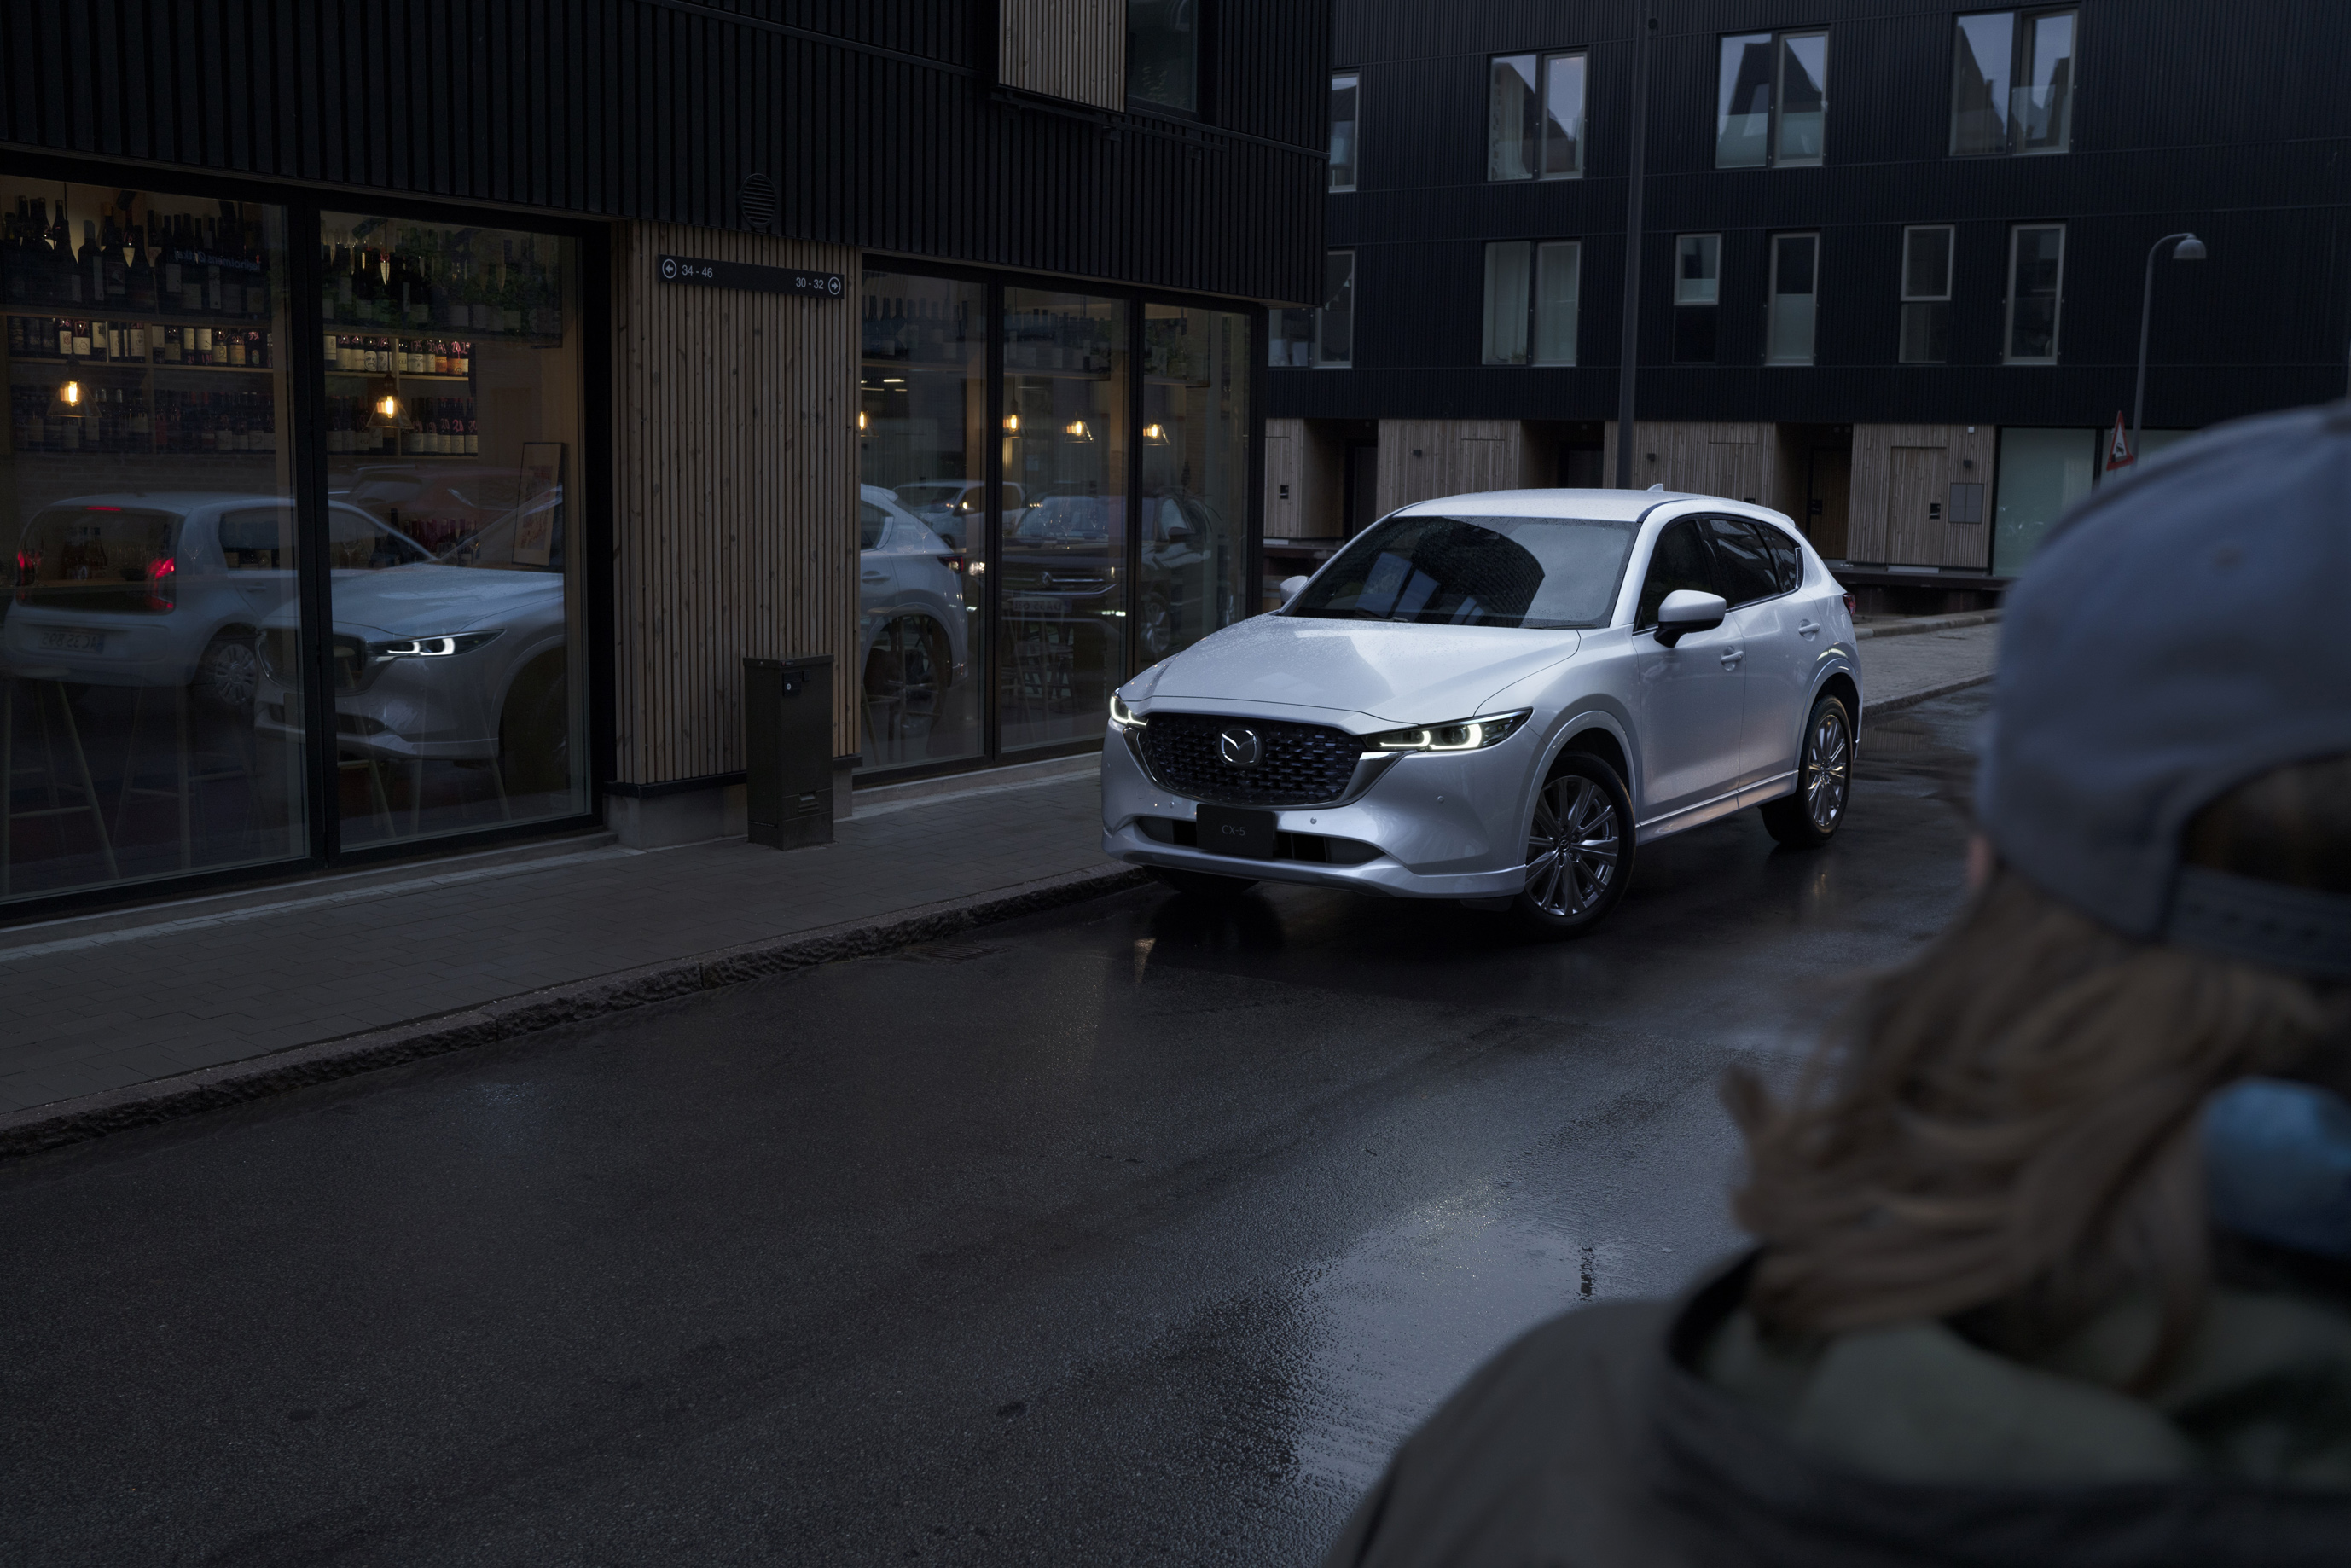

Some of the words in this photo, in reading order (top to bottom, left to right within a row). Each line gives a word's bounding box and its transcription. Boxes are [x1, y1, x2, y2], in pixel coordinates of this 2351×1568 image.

[682, 264, 694, 276] 34
[701, 267, 713, 278] 46
[795, 277, 806, 287] 30
[813, 279, 824, 290] 32
[1222, 824, 1245, 836] CX-5
